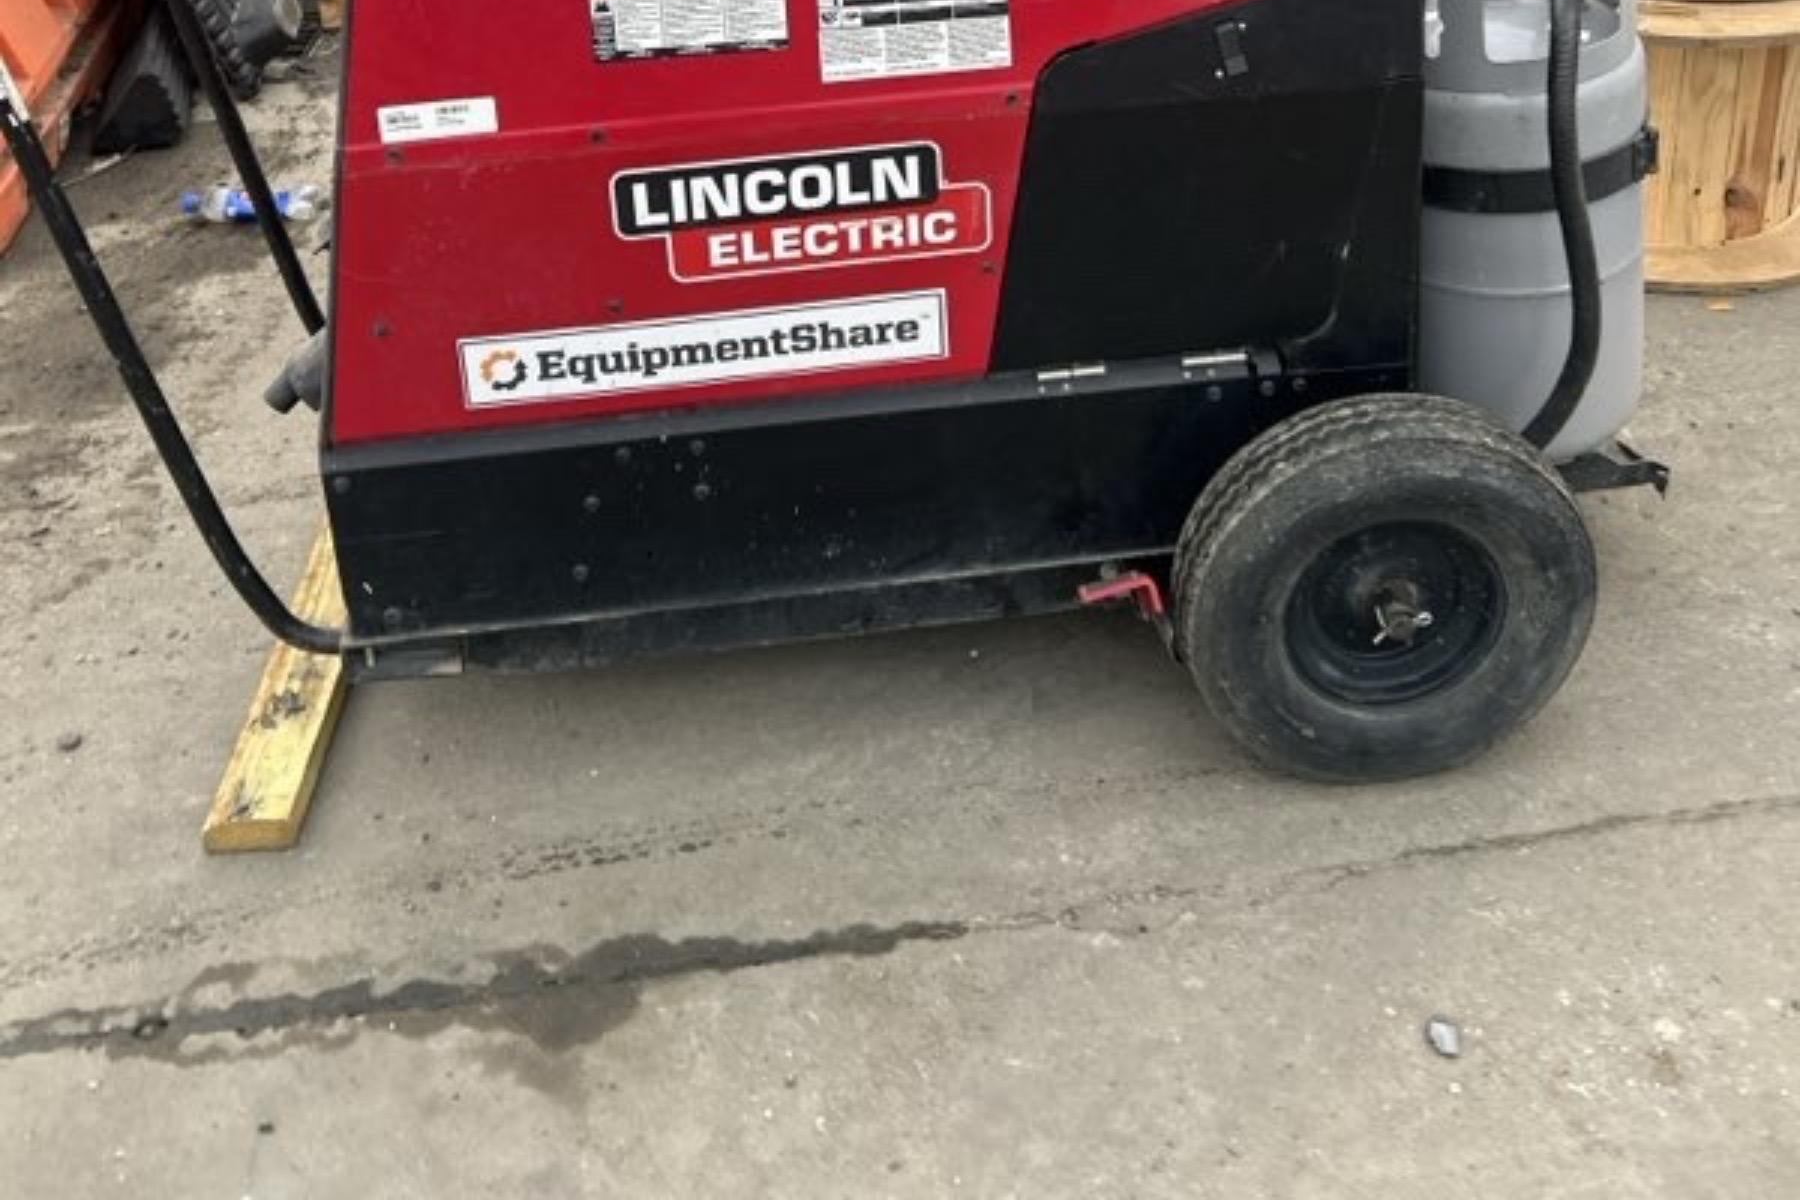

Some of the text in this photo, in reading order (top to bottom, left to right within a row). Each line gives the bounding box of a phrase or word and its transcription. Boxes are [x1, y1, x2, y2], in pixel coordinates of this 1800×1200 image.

[632, 154, 921, 227] LINCOLN
[706, 209, 959, 269] ELECTRIC
[535, 317, 920, 384] EquipmentShare
